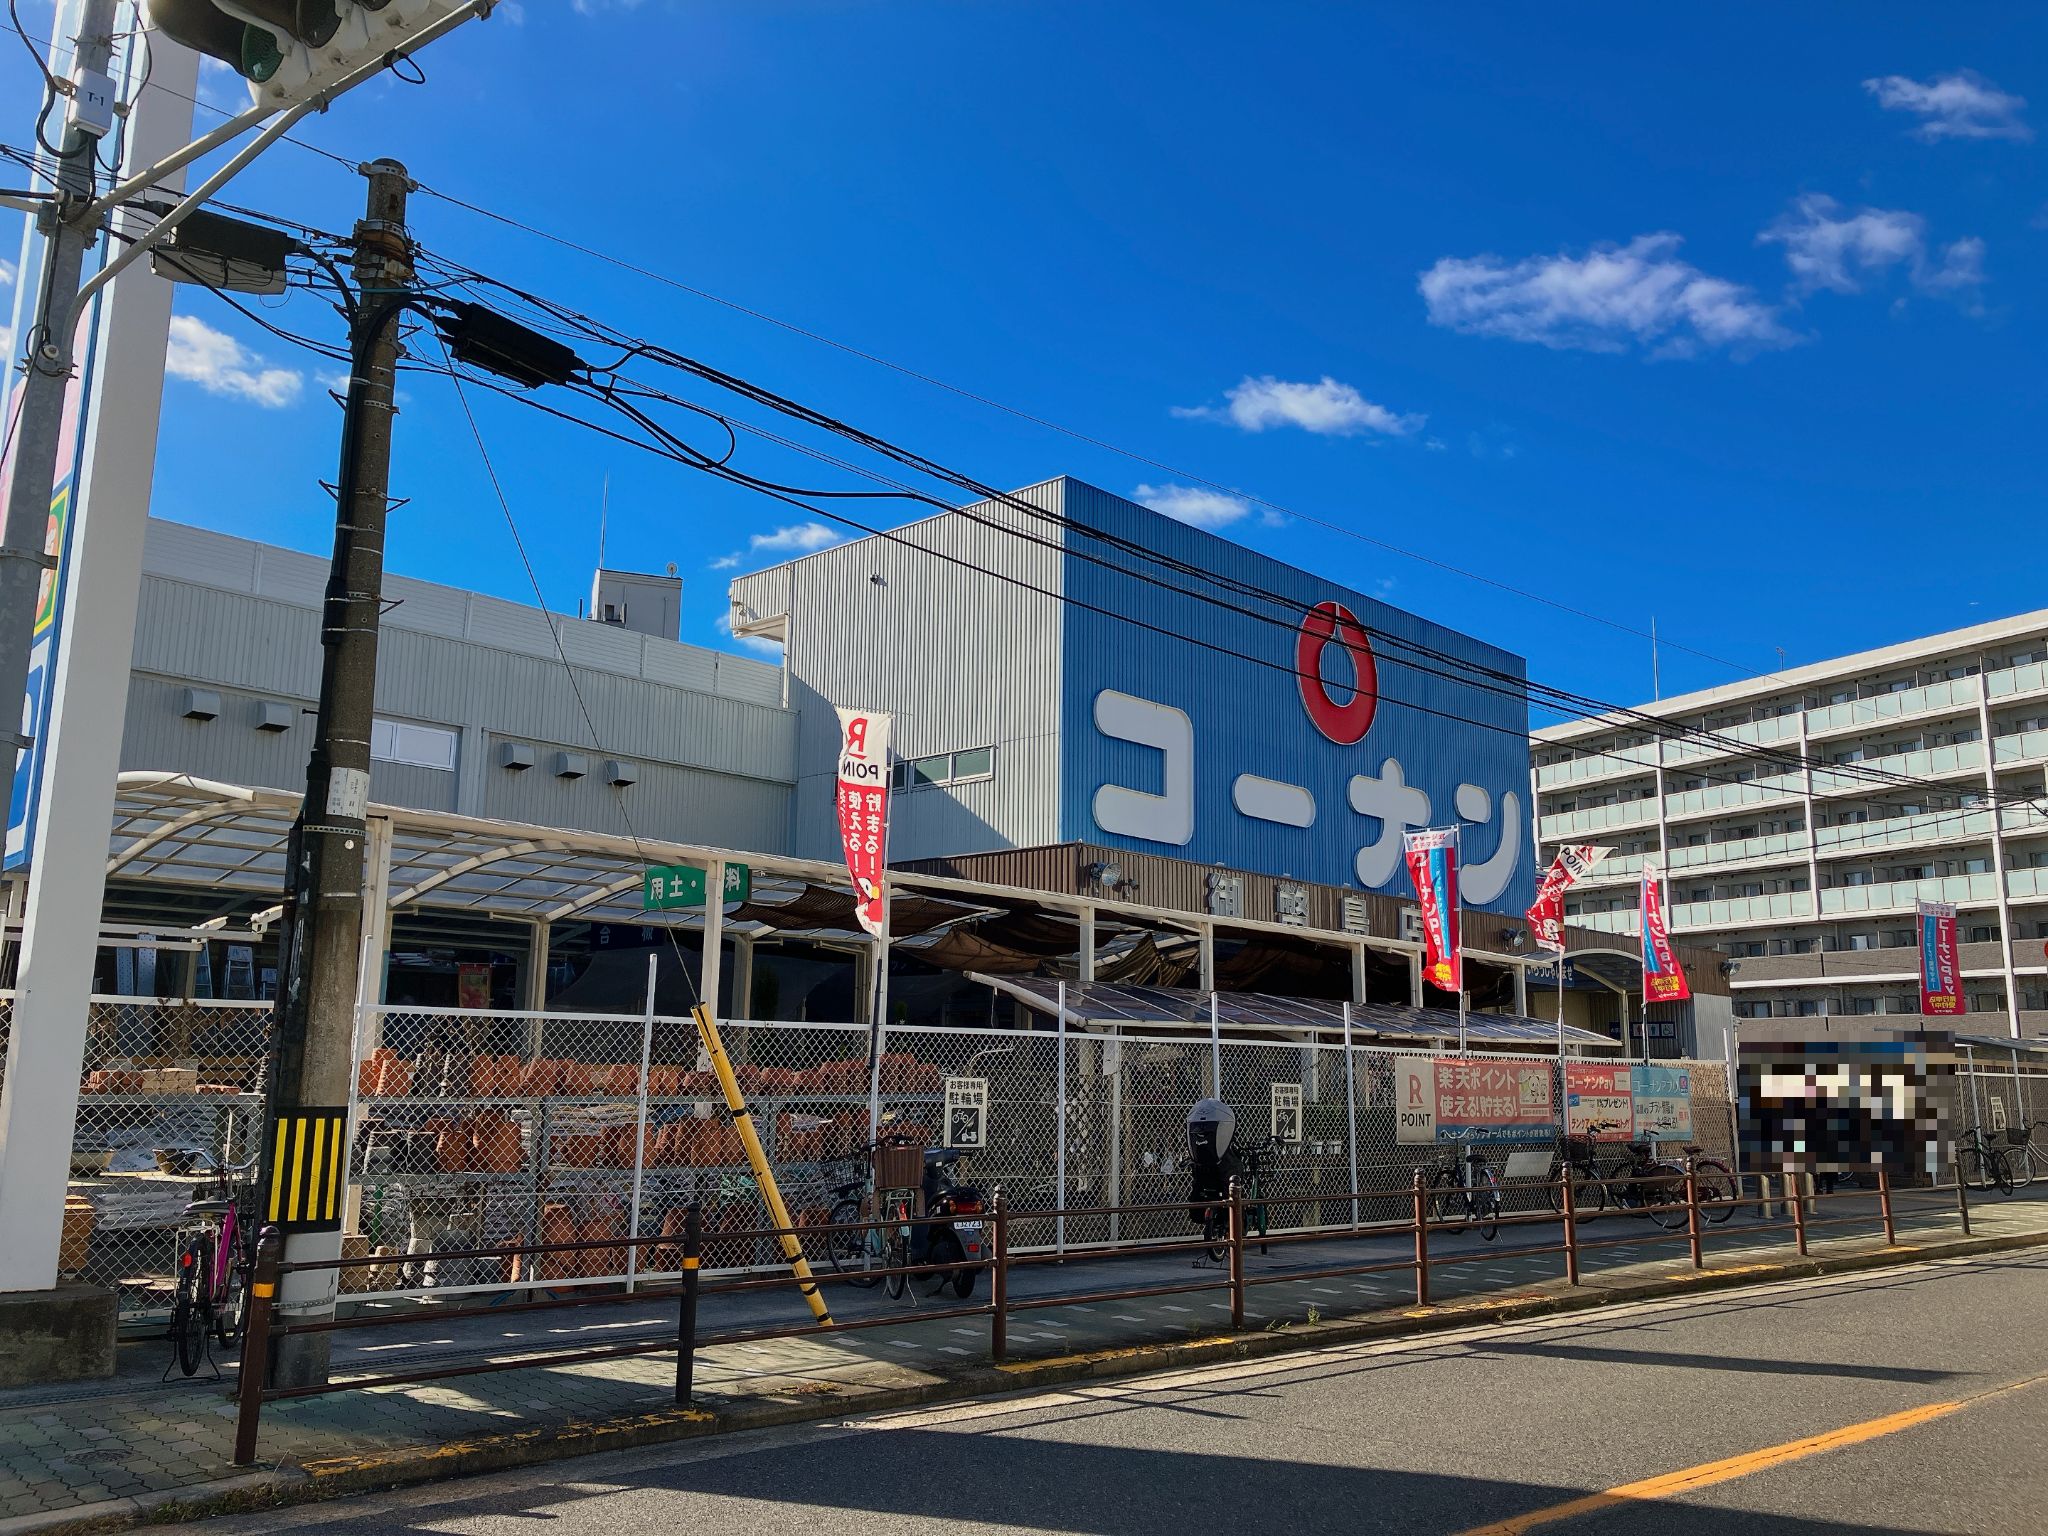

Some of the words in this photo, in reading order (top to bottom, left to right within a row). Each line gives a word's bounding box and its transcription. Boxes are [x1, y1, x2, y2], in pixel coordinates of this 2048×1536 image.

[87, 91, 104, 106] T-1
[1092, 688, 1521, 905] コーナン
[1561, 846, 1586, 876] POIN
[949, 1080, 984, 1090] お客様専用
[1438, 1066, 1516, 1091] 楽天ポイント
[1567, 1075, 1614, 1093] コーナンPay
[1409, 1074, 1424, 1104] R
[948, 1091, 984, 1106] 駐輪場
[1401, 1113, 1431, 1127] POINT
